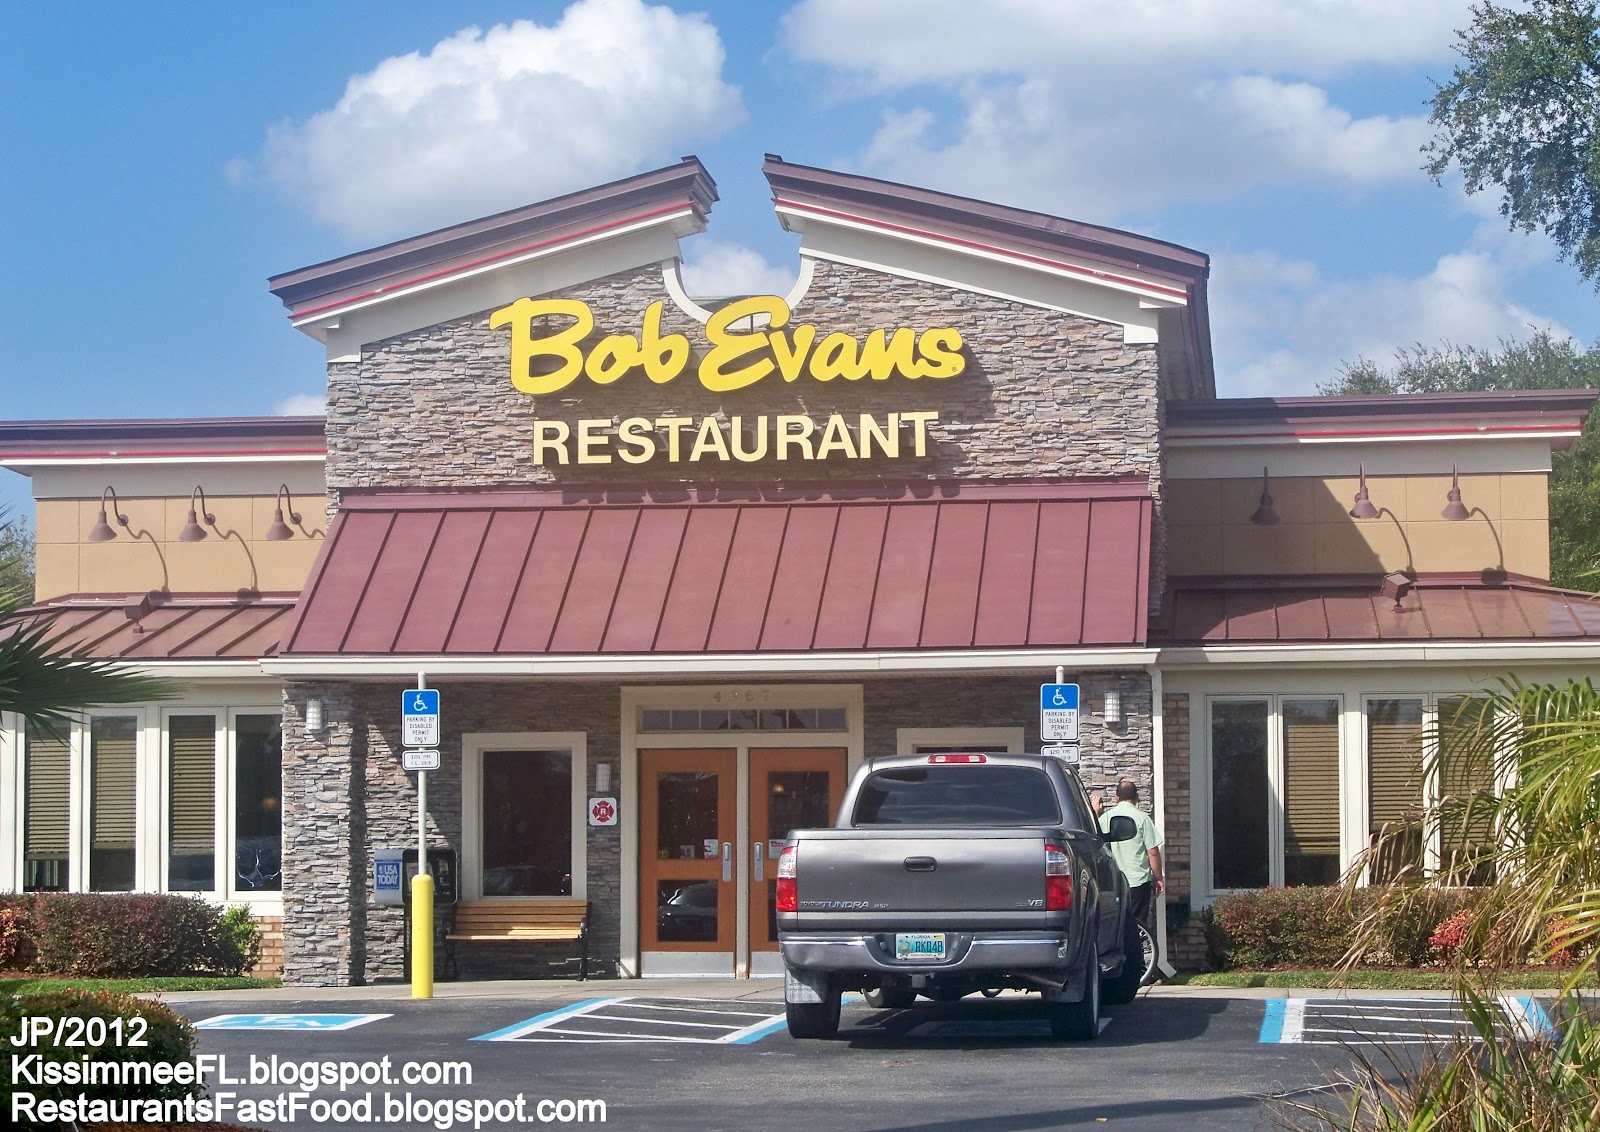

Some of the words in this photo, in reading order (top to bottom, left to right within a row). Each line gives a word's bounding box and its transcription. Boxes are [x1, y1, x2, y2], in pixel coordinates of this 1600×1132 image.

[489, 297, 690, 394] Bob
[698, 296, 966, 392] Evans
[533, 411, 939, 465] RESTAURANT
[378, 875, 398, 884] TODAY
[384, 865, 397, 874] USA
